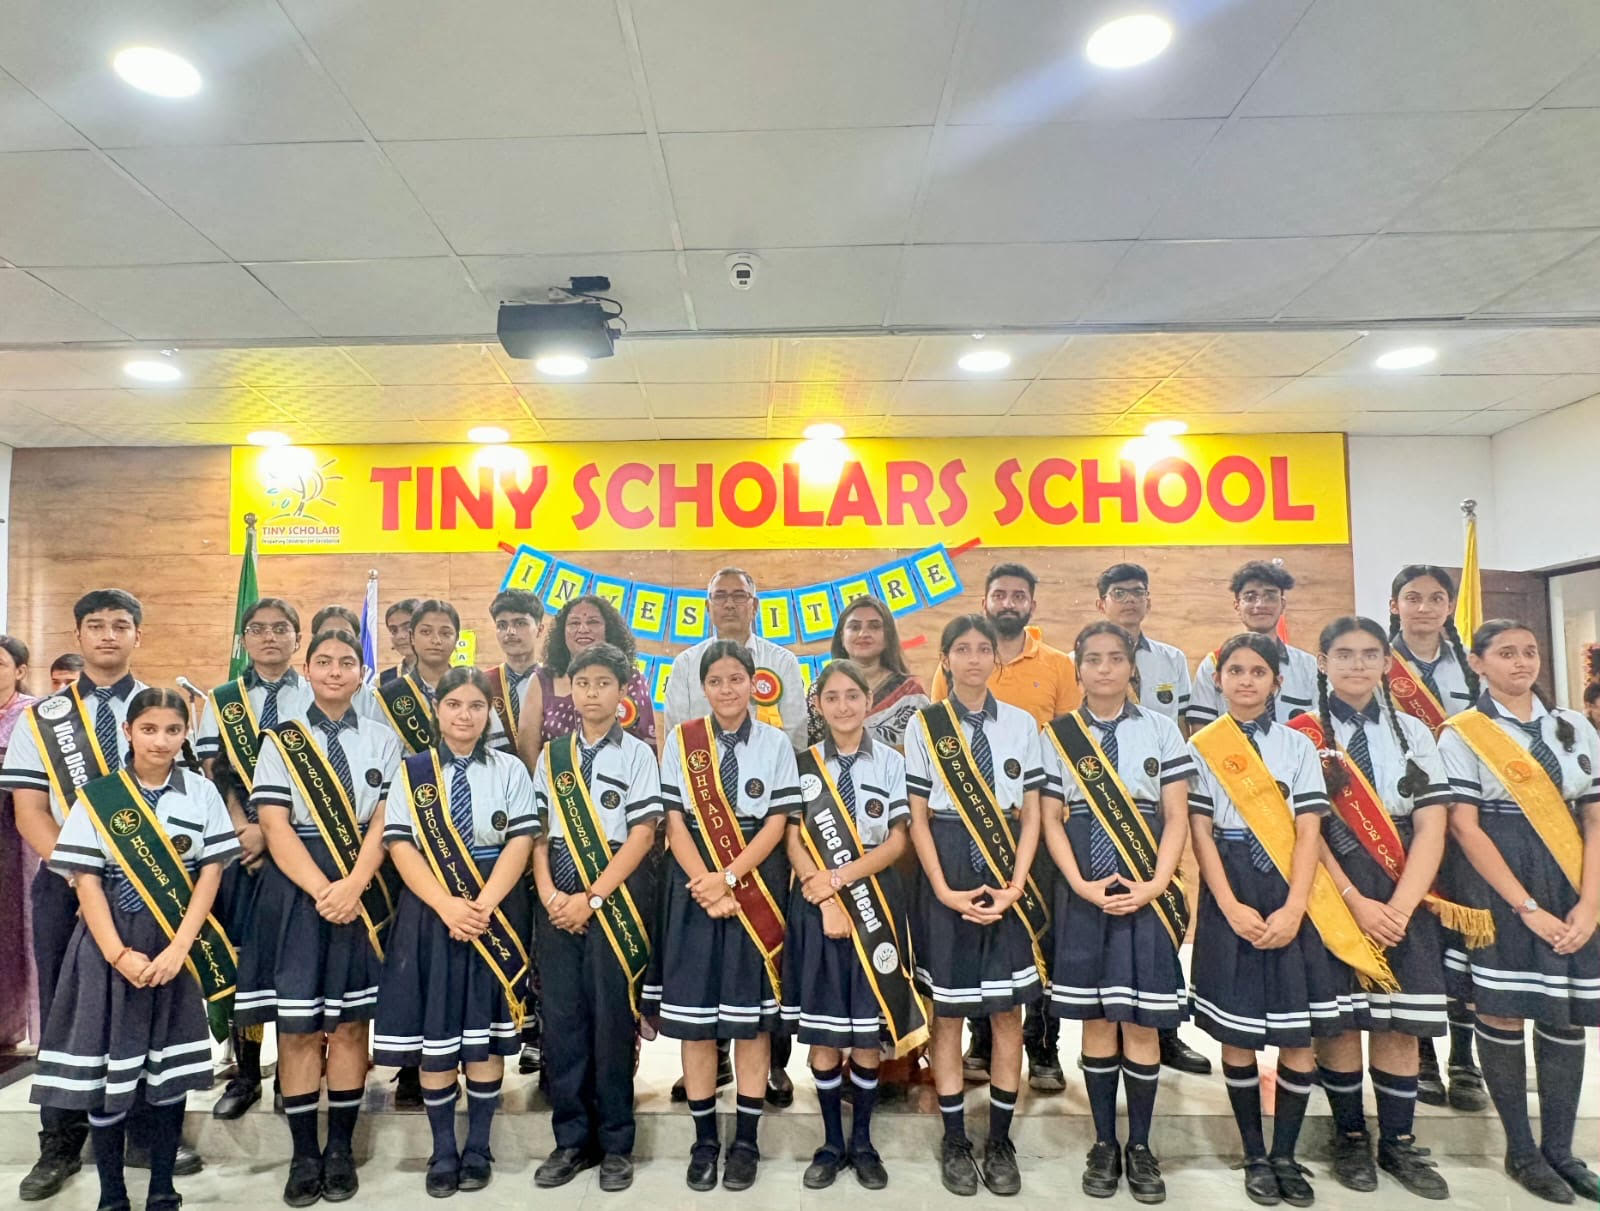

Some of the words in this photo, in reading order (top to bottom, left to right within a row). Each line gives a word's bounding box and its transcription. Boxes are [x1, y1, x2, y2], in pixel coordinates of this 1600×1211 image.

[262, 526, 286, 536] TINY
[370, 465, 548, 530] TINY
[571, 458, 968, 531] SCHOLARS
[993, 455, 1315, 526] SCHOOL
[53, 720, 77, 753] Vice
[232, 724, 258, 767] HOUS
[297, 752, 353, 847] DISCIPLINE
[695, 774, 724, 829] HEAD
[719, 834, 750, 889] GIL
[951, 759, 994, 829] SPORTS
[1350, 800, 1381, 842] VICE
[423, 807, 451, 858] HOUSE
[813, 807, 843, 851] Vice
[850, 883, 883, 934] Head
[1096, 782, 1123, 821] VICE
[1162, 887, 1187, 937] APTAIN
[129, 834, 171, 888] HOUSE
[166, 887, 187, 919] VIC
[565, 797, 592, 848] HOUSE
[586, 851, 604, 880] VIC
[606, 893, 639, 957] CAPTAIN
